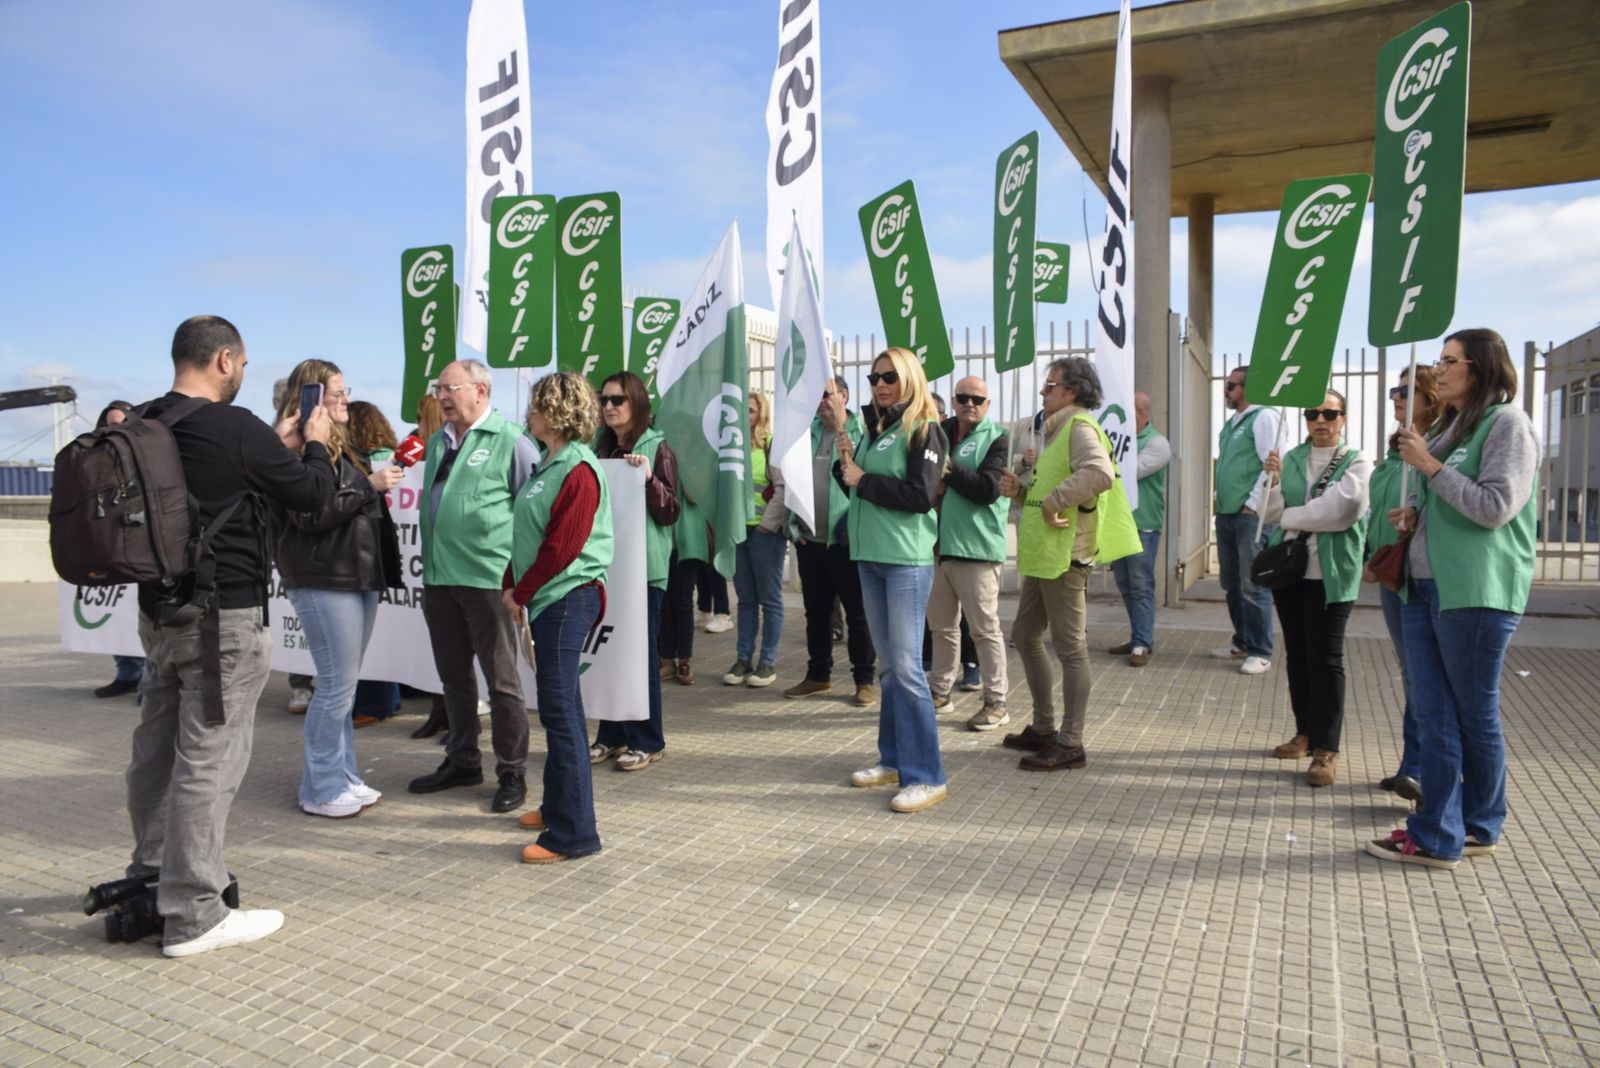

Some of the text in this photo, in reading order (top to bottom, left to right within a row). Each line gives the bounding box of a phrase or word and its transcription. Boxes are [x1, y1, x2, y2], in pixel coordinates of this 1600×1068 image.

[1398, 46, 1458, 102] CSIF
[1005, 159, 1033, 195] CSIF
[507, 213, 549, 233] CSIF
[571, 215, 614, 238] CSIF
[878, 204, 912, 240] CSIF
[1299, 202, 1357, 228] CSIF
[1393, 131, 1432, 333] CSIF
[415, 263, 448, 282] CSIF
[1034, 262, 1063, 281] SIF
[1006, 216, 1021, 362] CSIF
[508, 252, 533, 362] CSIF
[578, 260, 600, 379] CSIF
[644, 310, 675, 324] CSIF
[1270, 255, 1325, 398] CSIF
[83, 585, 128, 607] CSIF
[582, 625, 615, 655] IF
